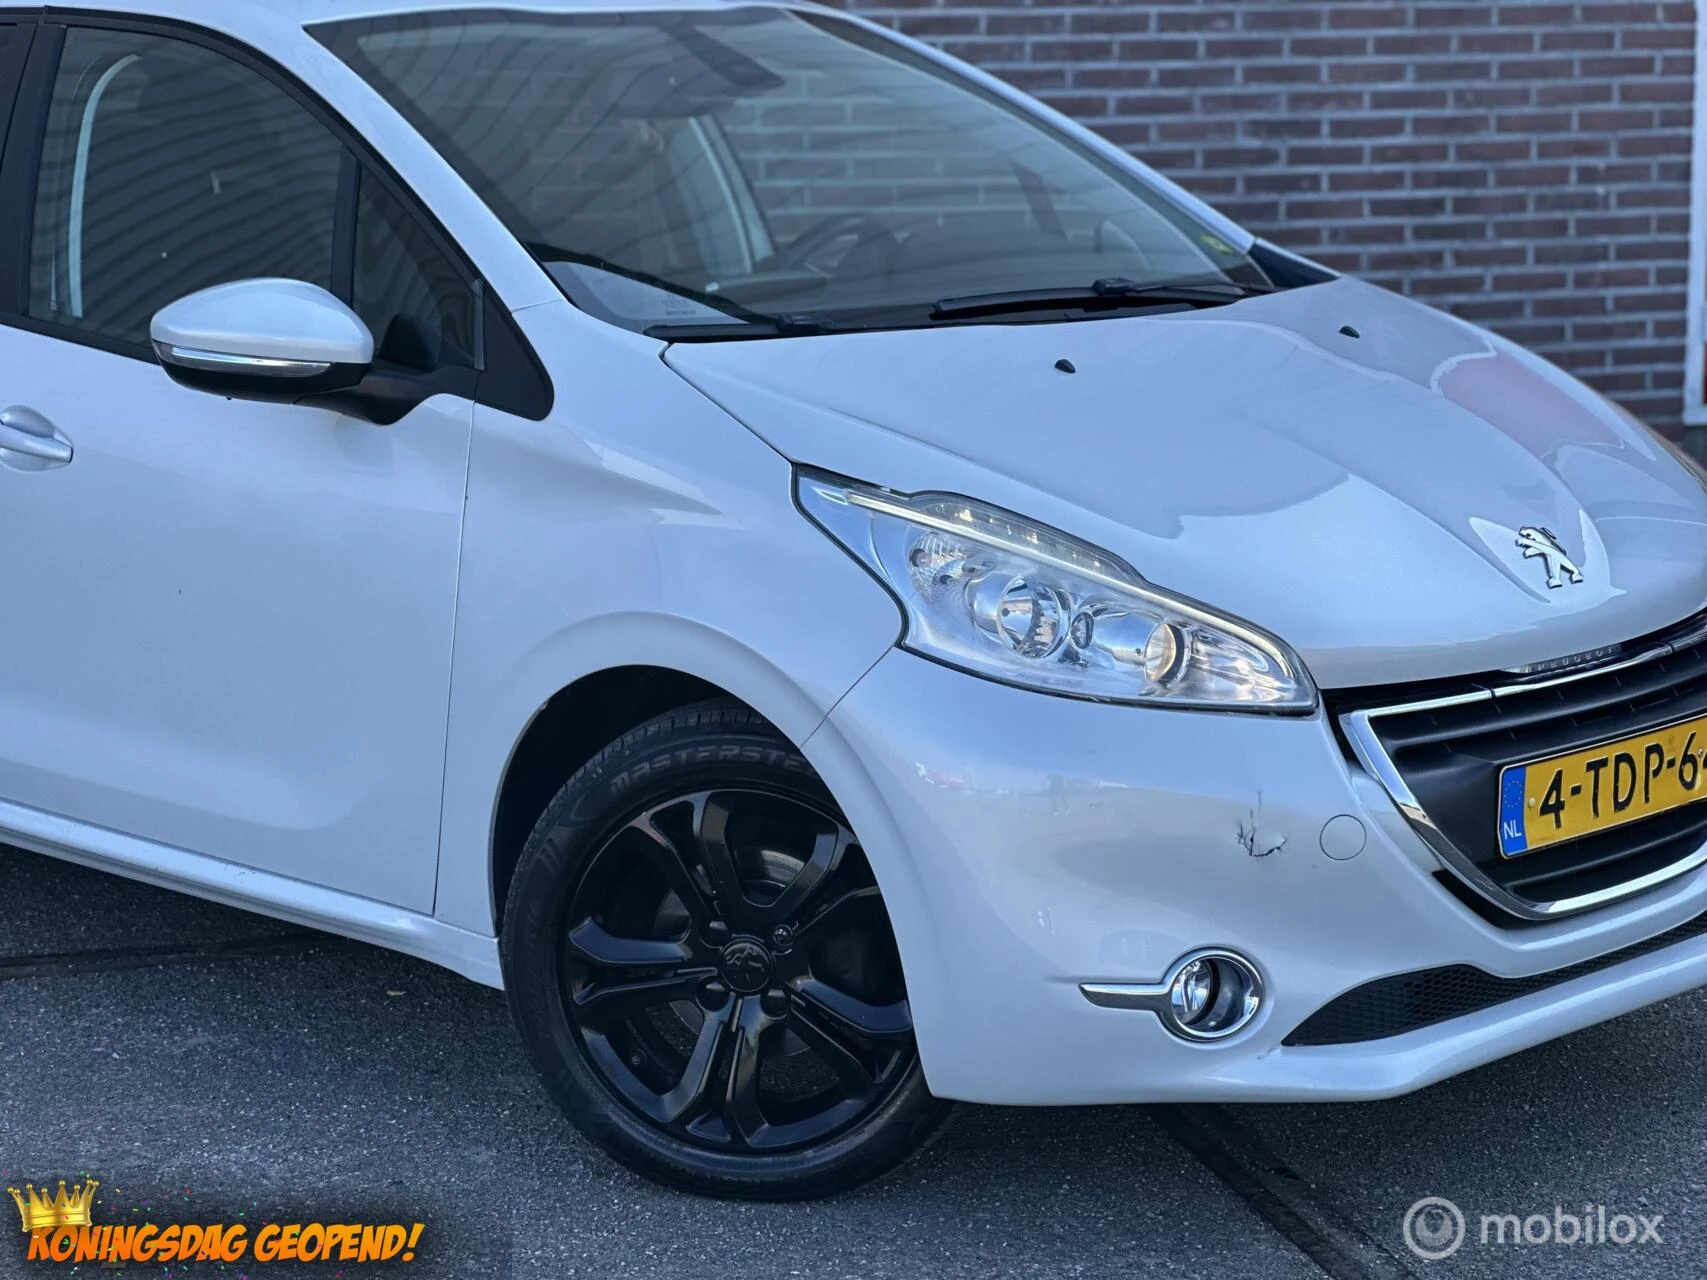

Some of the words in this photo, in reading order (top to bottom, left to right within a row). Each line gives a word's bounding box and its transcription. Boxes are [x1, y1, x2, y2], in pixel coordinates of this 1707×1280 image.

[610, 744, 816, 794] MASTERSTE
[1539, 731, 1707, 829] 4-TDP-6
[1503, 821, 1522, 840] NL
